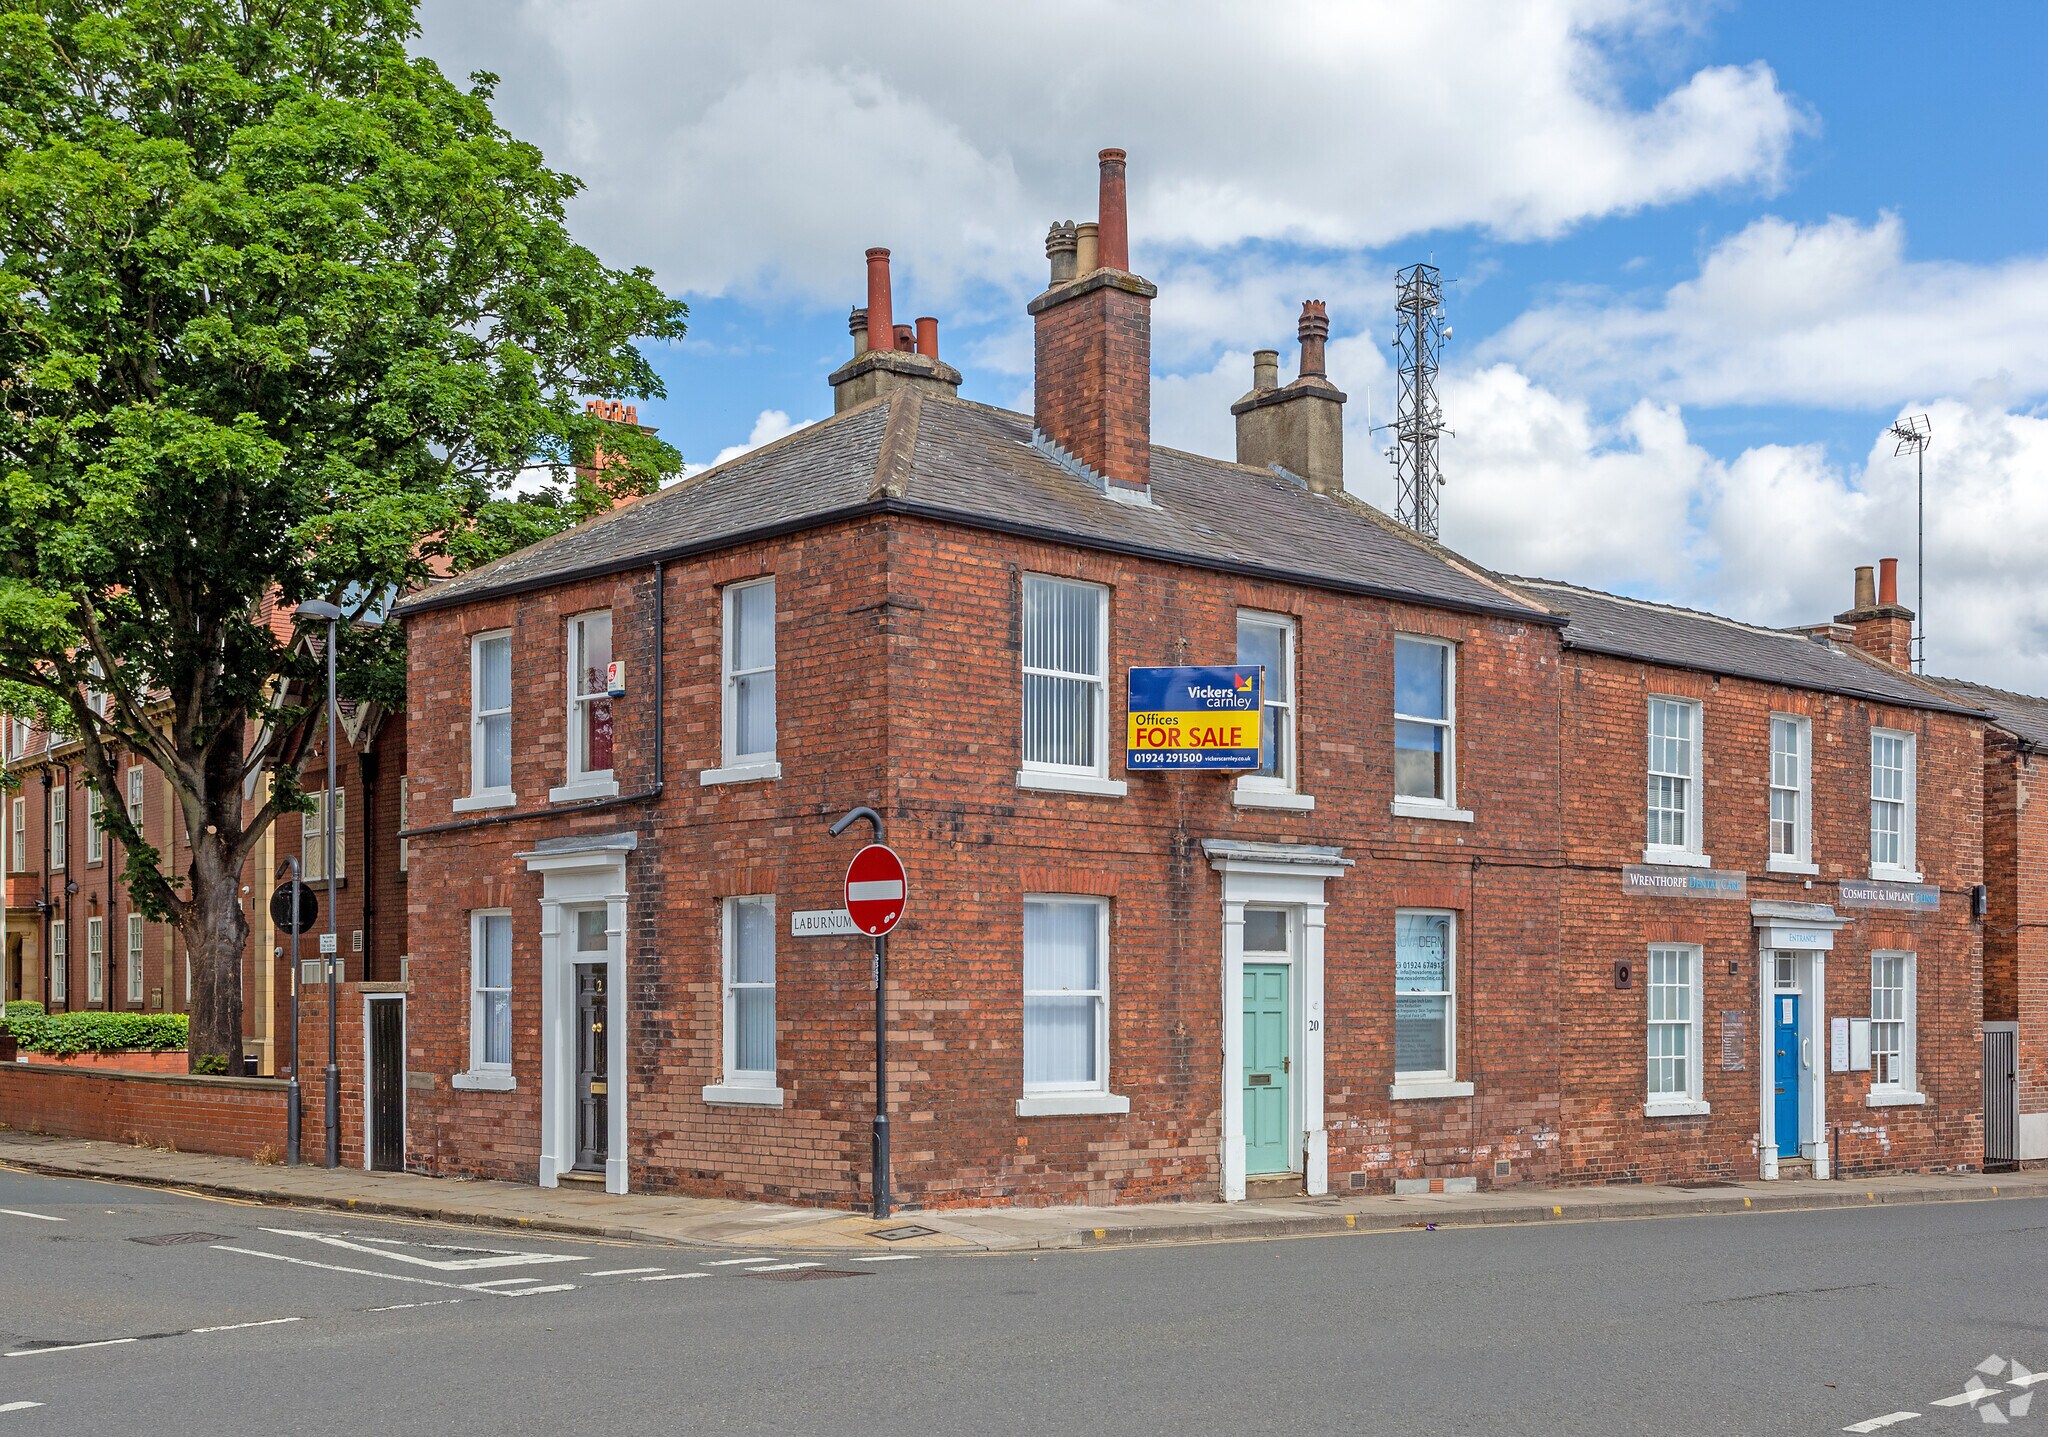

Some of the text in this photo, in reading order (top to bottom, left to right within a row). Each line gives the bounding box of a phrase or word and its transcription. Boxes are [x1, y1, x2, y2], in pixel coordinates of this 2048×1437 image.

[1188, 686, 1233, 699] Vickers
[1206, 695, 1252, 710] carnley
[1136, 714, 1179, 726] Offices
[1136, 727, 1242, 747] FOR SALE
[1134, 753, 1164, 763] 01924
[1166, 753, 1203, 763] 291500
[1630, 873, 1742, 891] WRENTHORPE DENTAL CARE
[1842, 887, 1938, 904] COSMETIC & IMPLANT CLINIC
[795, 915, 852, 930] LABURNUM
[1789, 933, 1817, 943] ENTRANCE
[1403, 961, 1421, 969] 01924
[1308, 1020, 1319, 1031] 20
